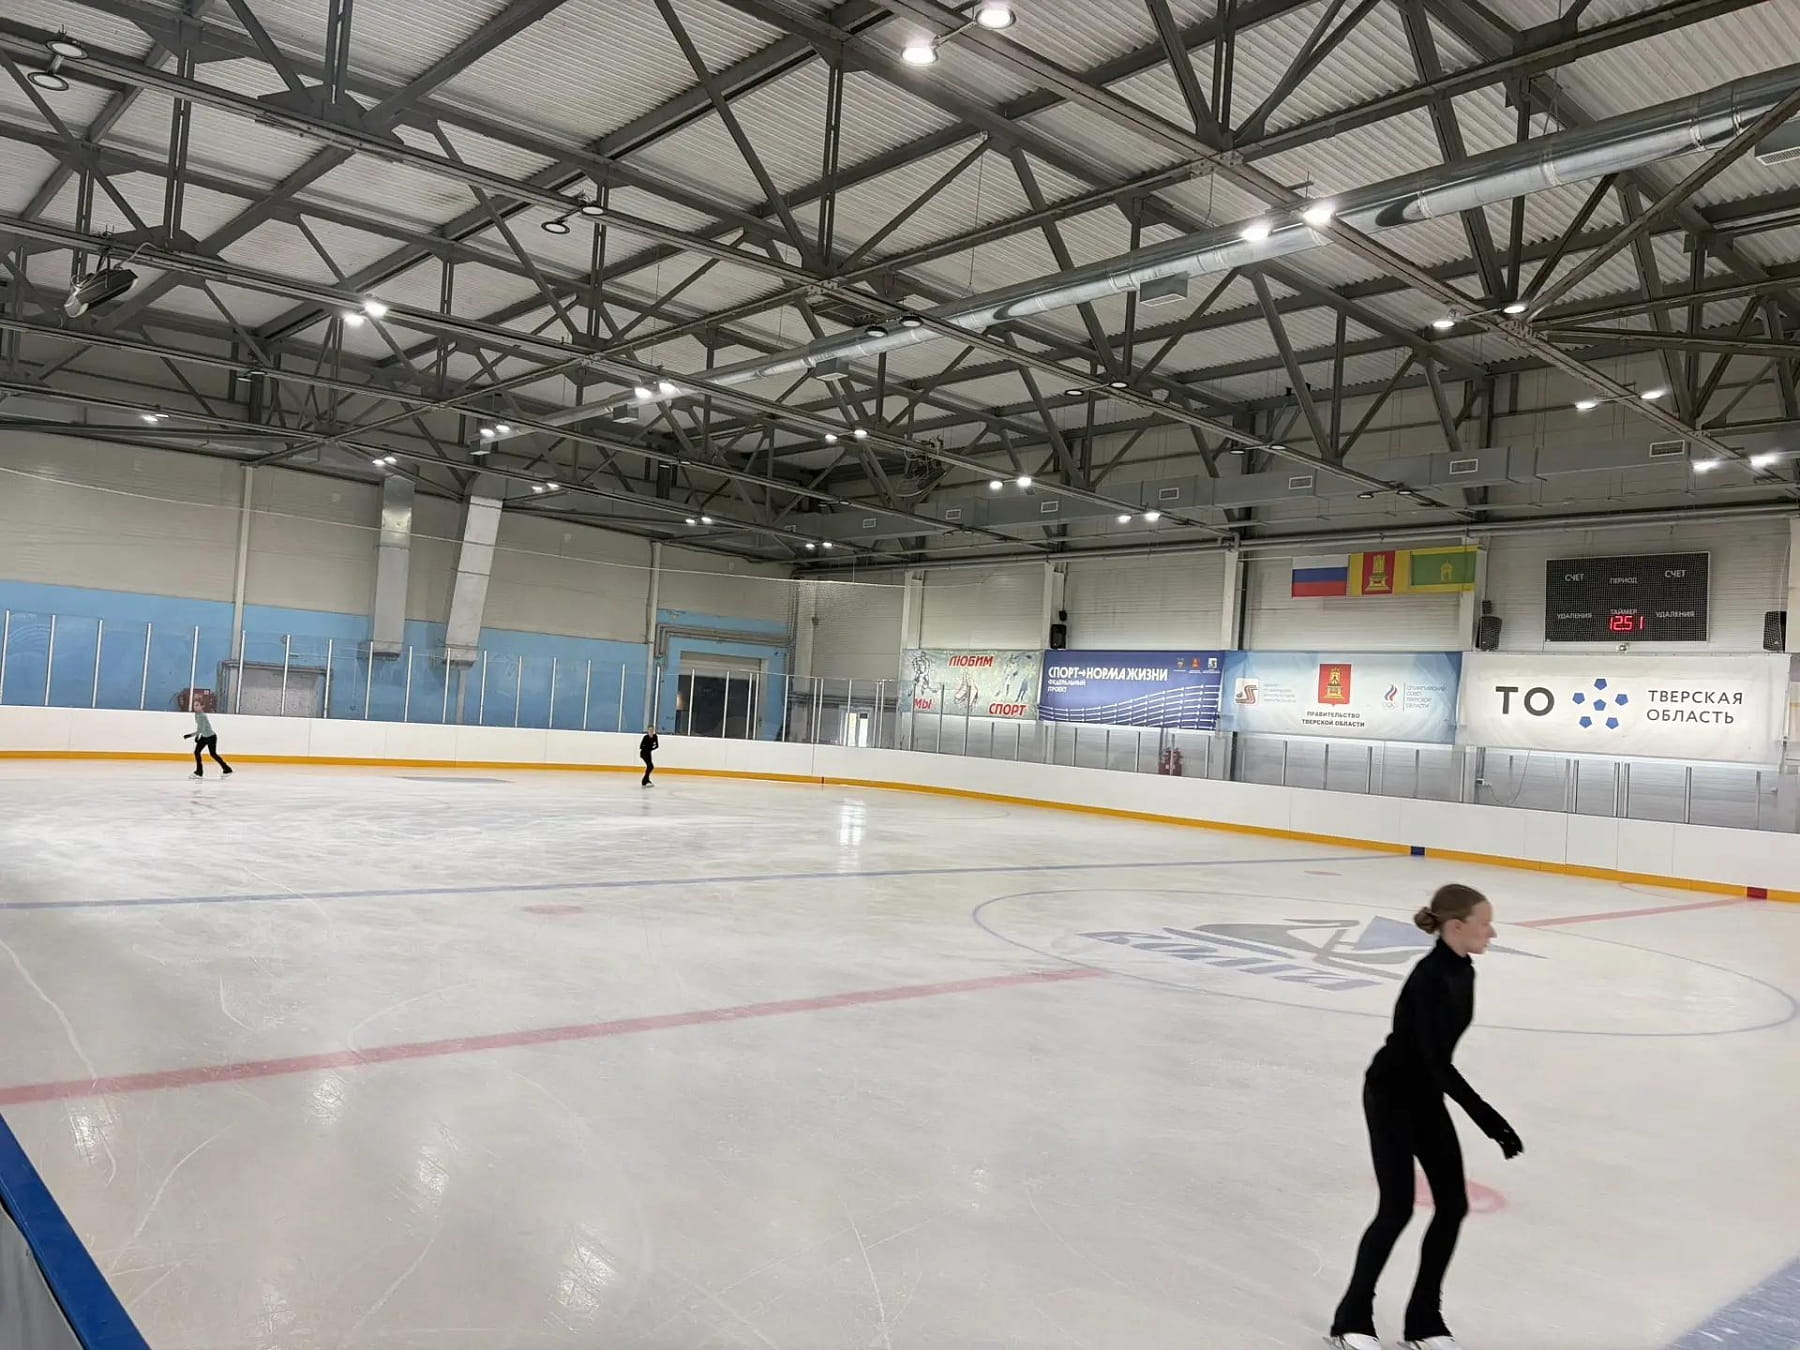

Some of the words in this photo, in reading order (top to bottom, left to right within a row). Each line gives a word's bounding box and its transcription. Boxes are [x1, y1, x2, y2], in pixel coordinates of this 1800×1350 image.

[1564, 573, 1585, 582] СЧЕТ
[1665, 569, 1686, 578] СЧЕТ
[948, 655, 994, 667] ЛЮБИМ
[1126, 668, 1168, 681] ЖИЗНИ
[1495, 686, 1555, 716] ТО
[1647, 690, 1743, 705] ТВЕРСКАЯ
[914, 698, 932, 710] МЫ
[988, 703, 1027, 716] СПОРТ
[1306, 711, 1361, 719] ПРАВИТЕЛЬСТВО
[1646, 709, 1734, 724] ОБЛАСТЬ
[1302, 718, 1334, 726] ТВЕРСКОЙ
[1334, 720, 1365, 728] ОБЛАСТИ
